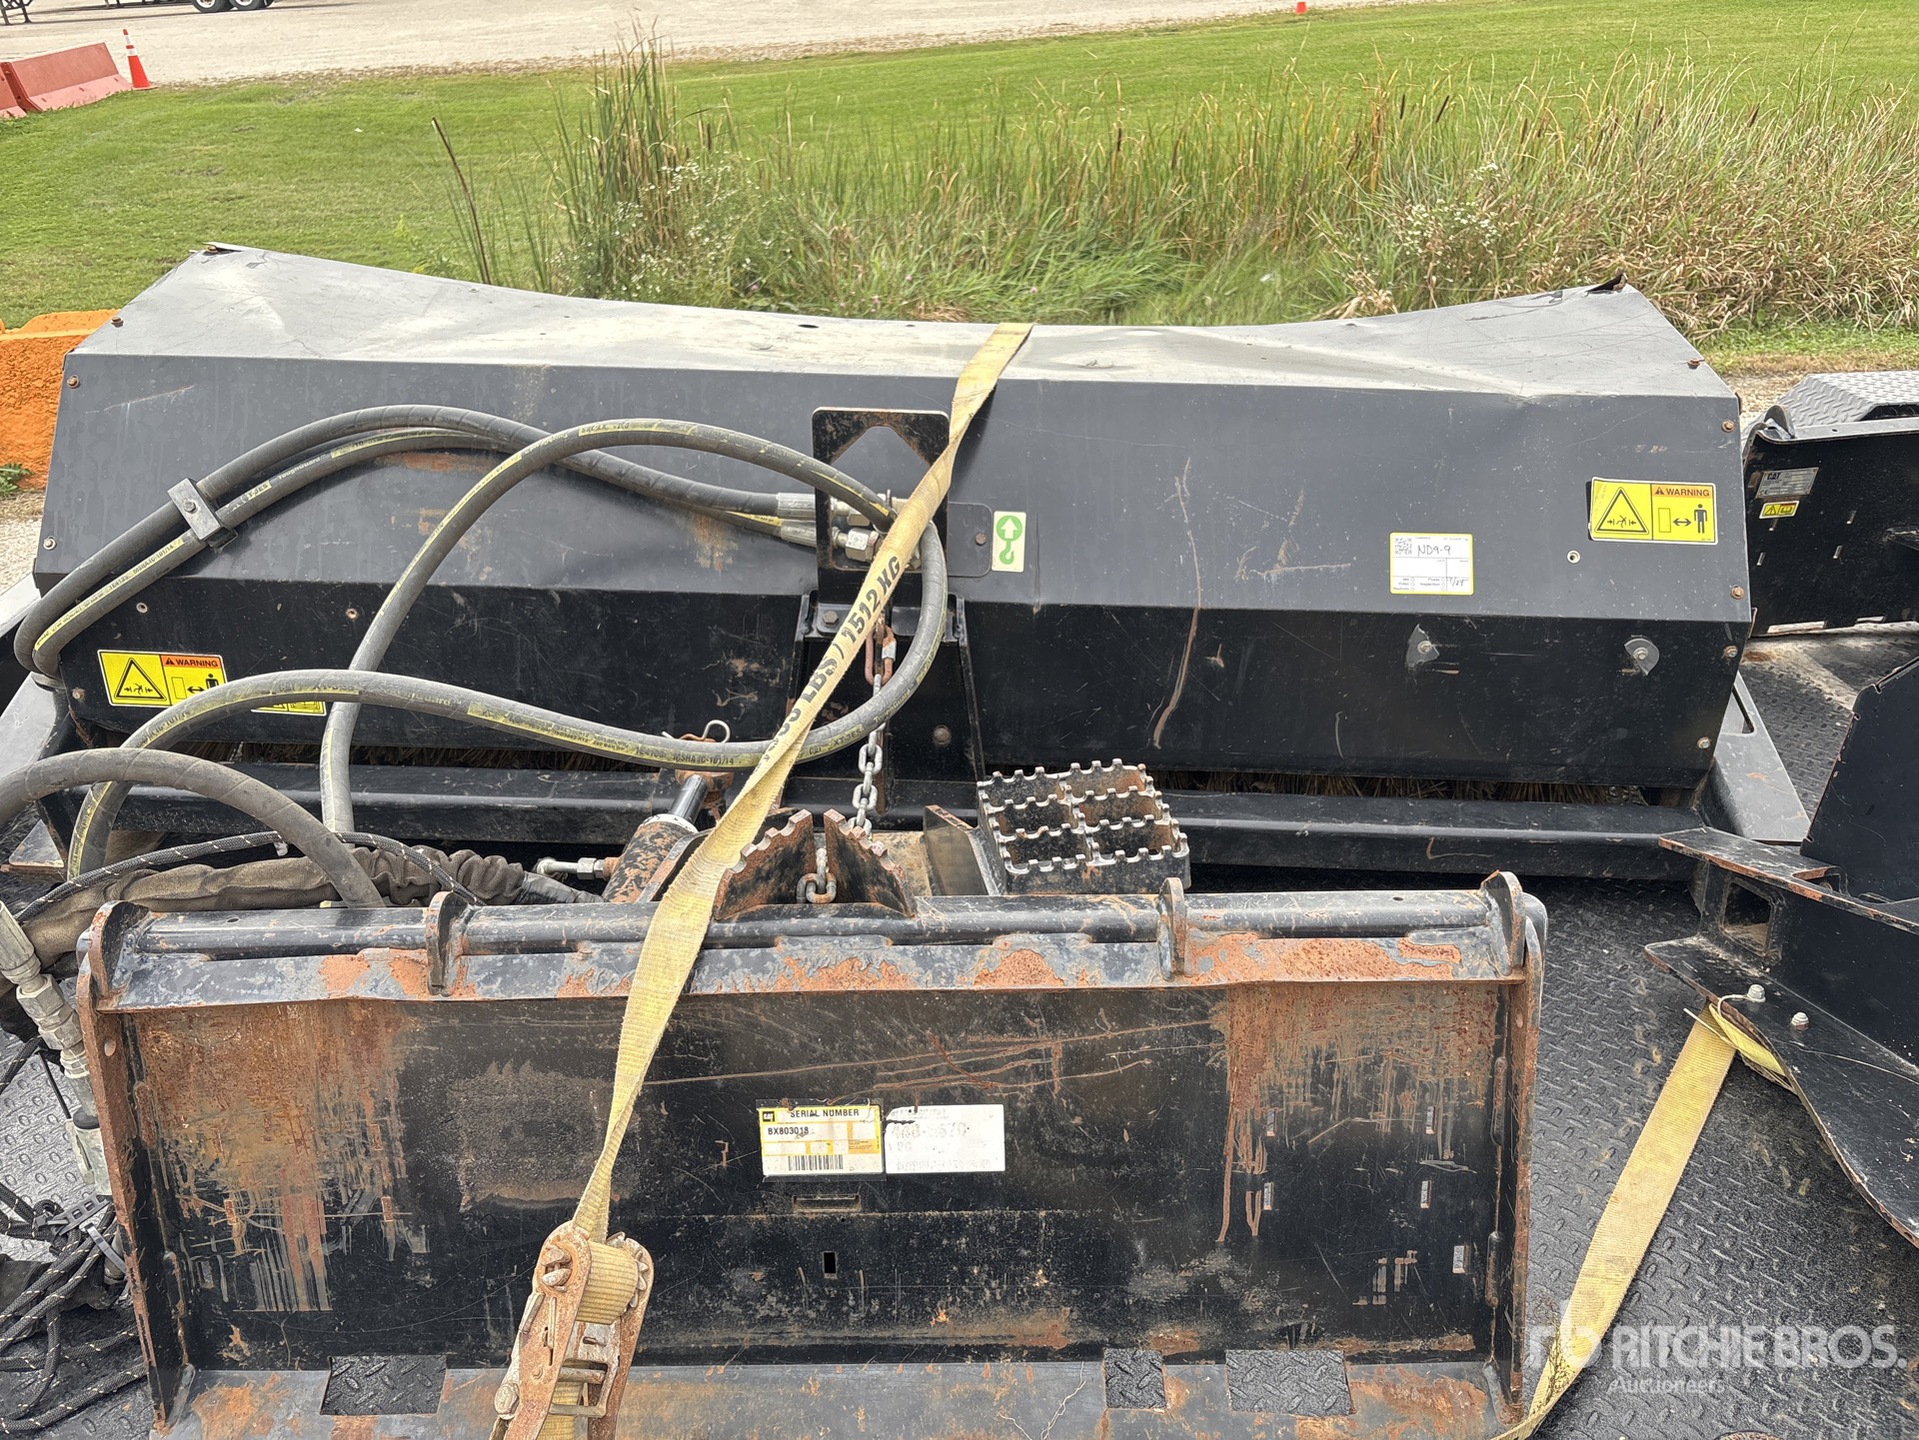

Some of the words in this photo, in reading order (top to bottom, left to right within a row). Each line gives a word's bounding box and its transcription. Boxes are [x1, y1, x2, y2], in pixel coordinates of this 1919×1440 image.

[1666, 487, 1710, 497] WARNING
[842, 589, 881, 645] 1512
[878, 555, 902, 595] KG
[175, 658, 219, 668] WARNING
[789, 1110, 820, 1118] SERIAL
[822, 1108, 860, 1117] NUMBER
